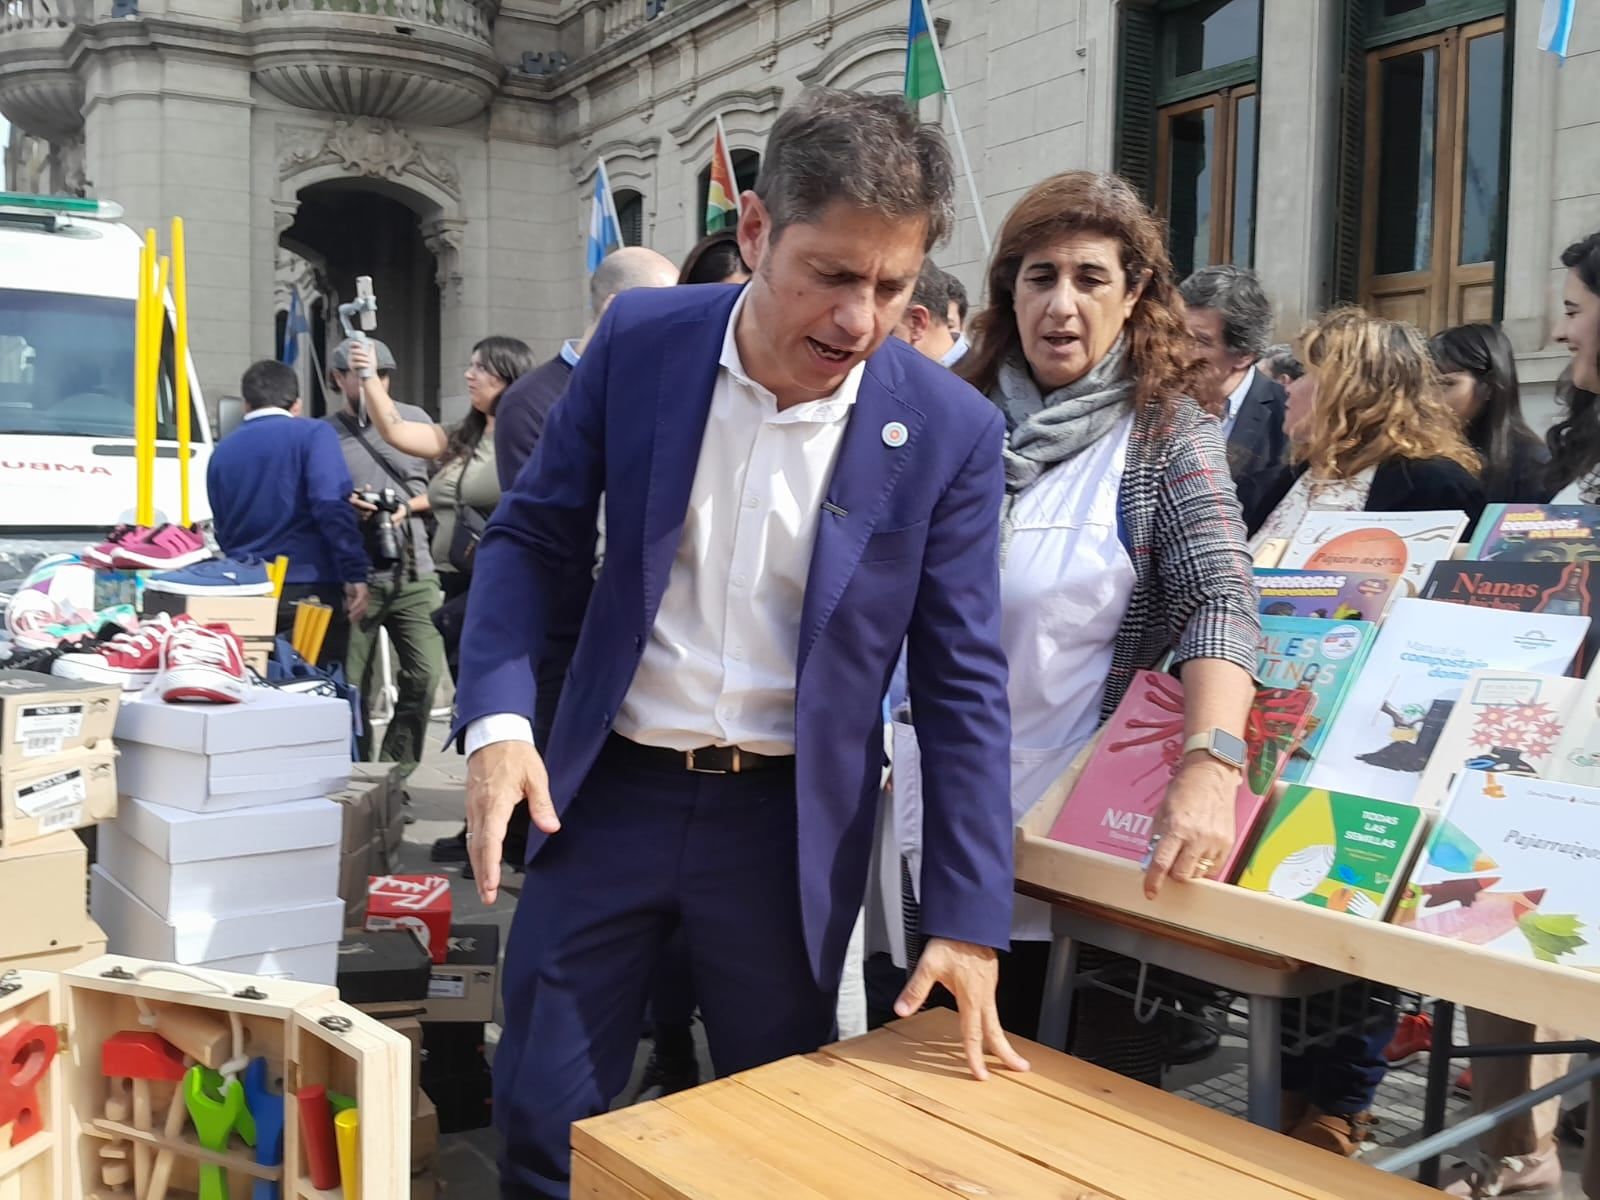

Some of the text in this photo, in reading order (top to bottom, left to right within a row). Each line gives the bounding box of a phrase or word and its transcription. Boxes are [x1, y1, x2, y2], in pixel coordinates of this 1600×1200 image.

[1451, 572, 1539, 598] Nanas
[1362, 810, 1399, 825] TODAS
[1364, 823, 1387, 834] LAS
[1344, 831, 1397, 849] SEMILLAS
